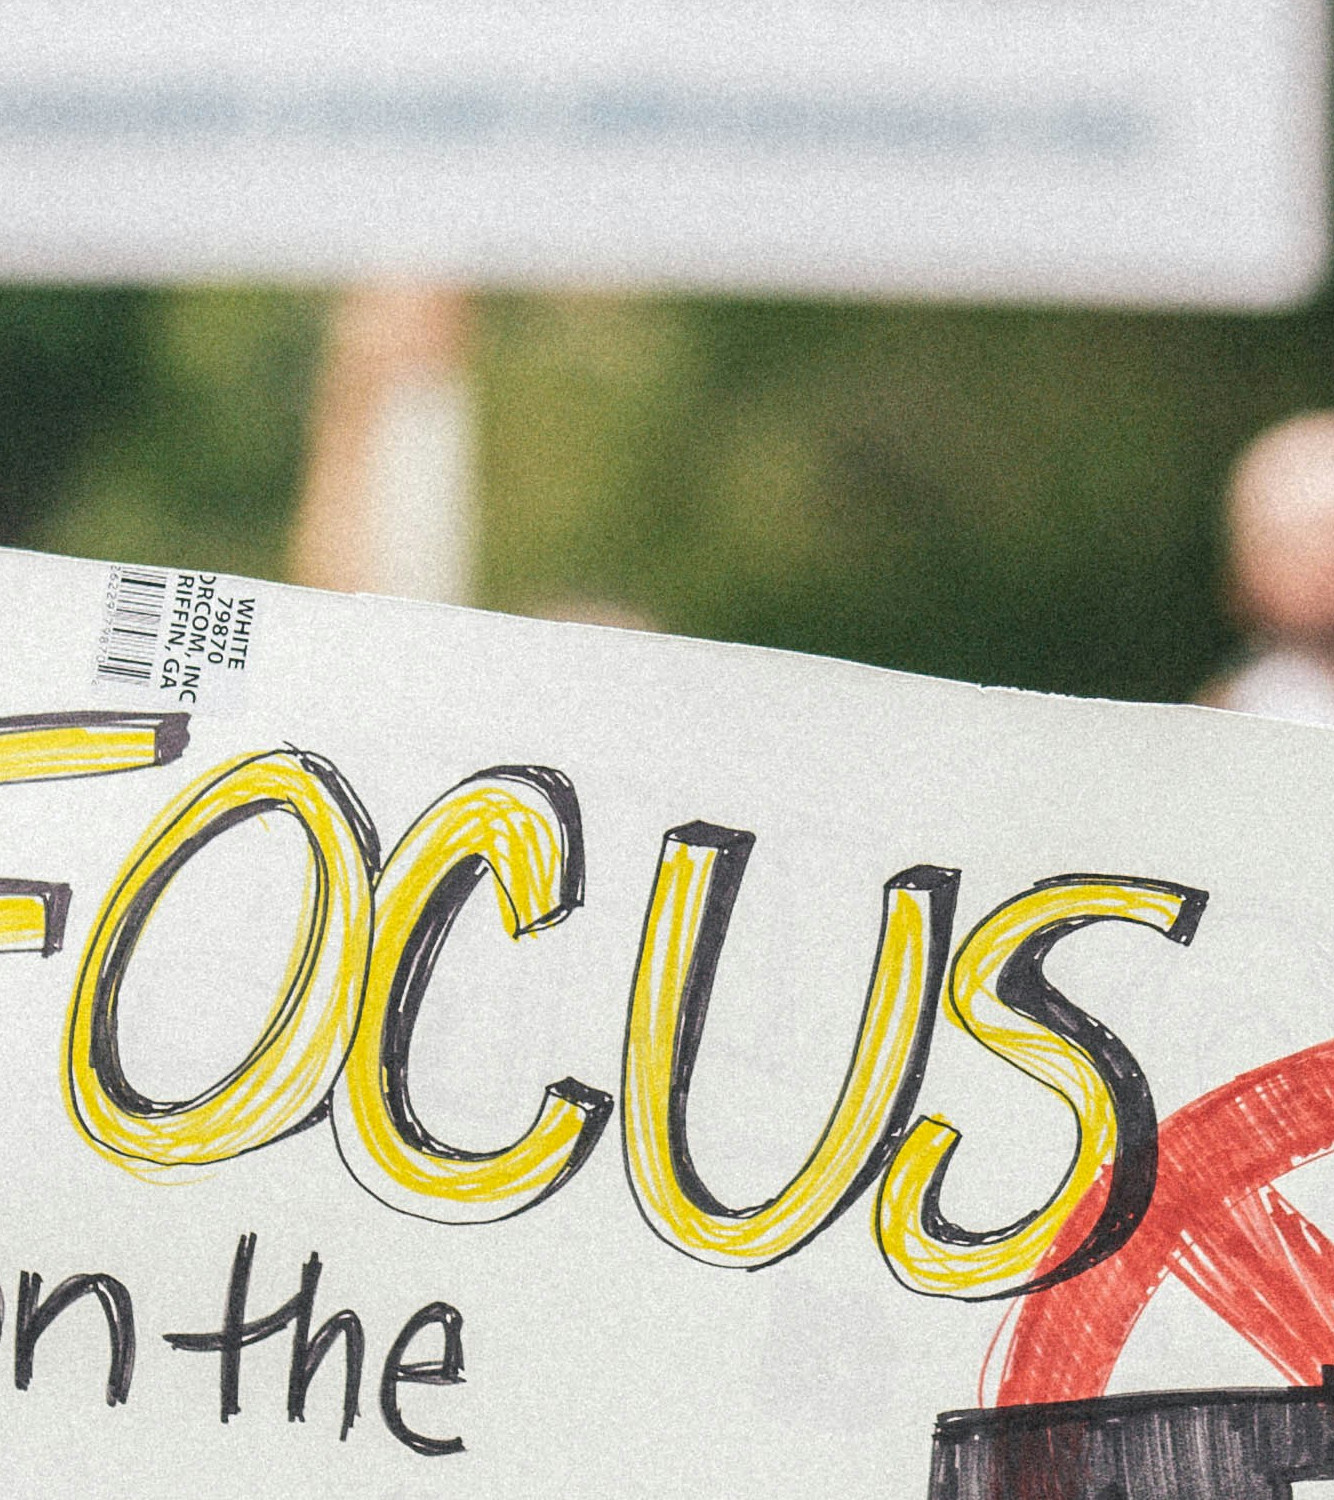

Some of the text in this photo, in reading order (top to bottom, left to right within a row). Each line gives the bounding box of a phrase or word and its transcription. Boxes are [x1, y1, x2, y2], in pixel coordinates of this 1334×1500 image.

[207, 597, 234, 664] 79870
[227, 598, 255, 670] WHITE
[160, 658, 180, 689] GA
[179, 665, 201, 703] INC
[163, 1231, 467, 1456] the
